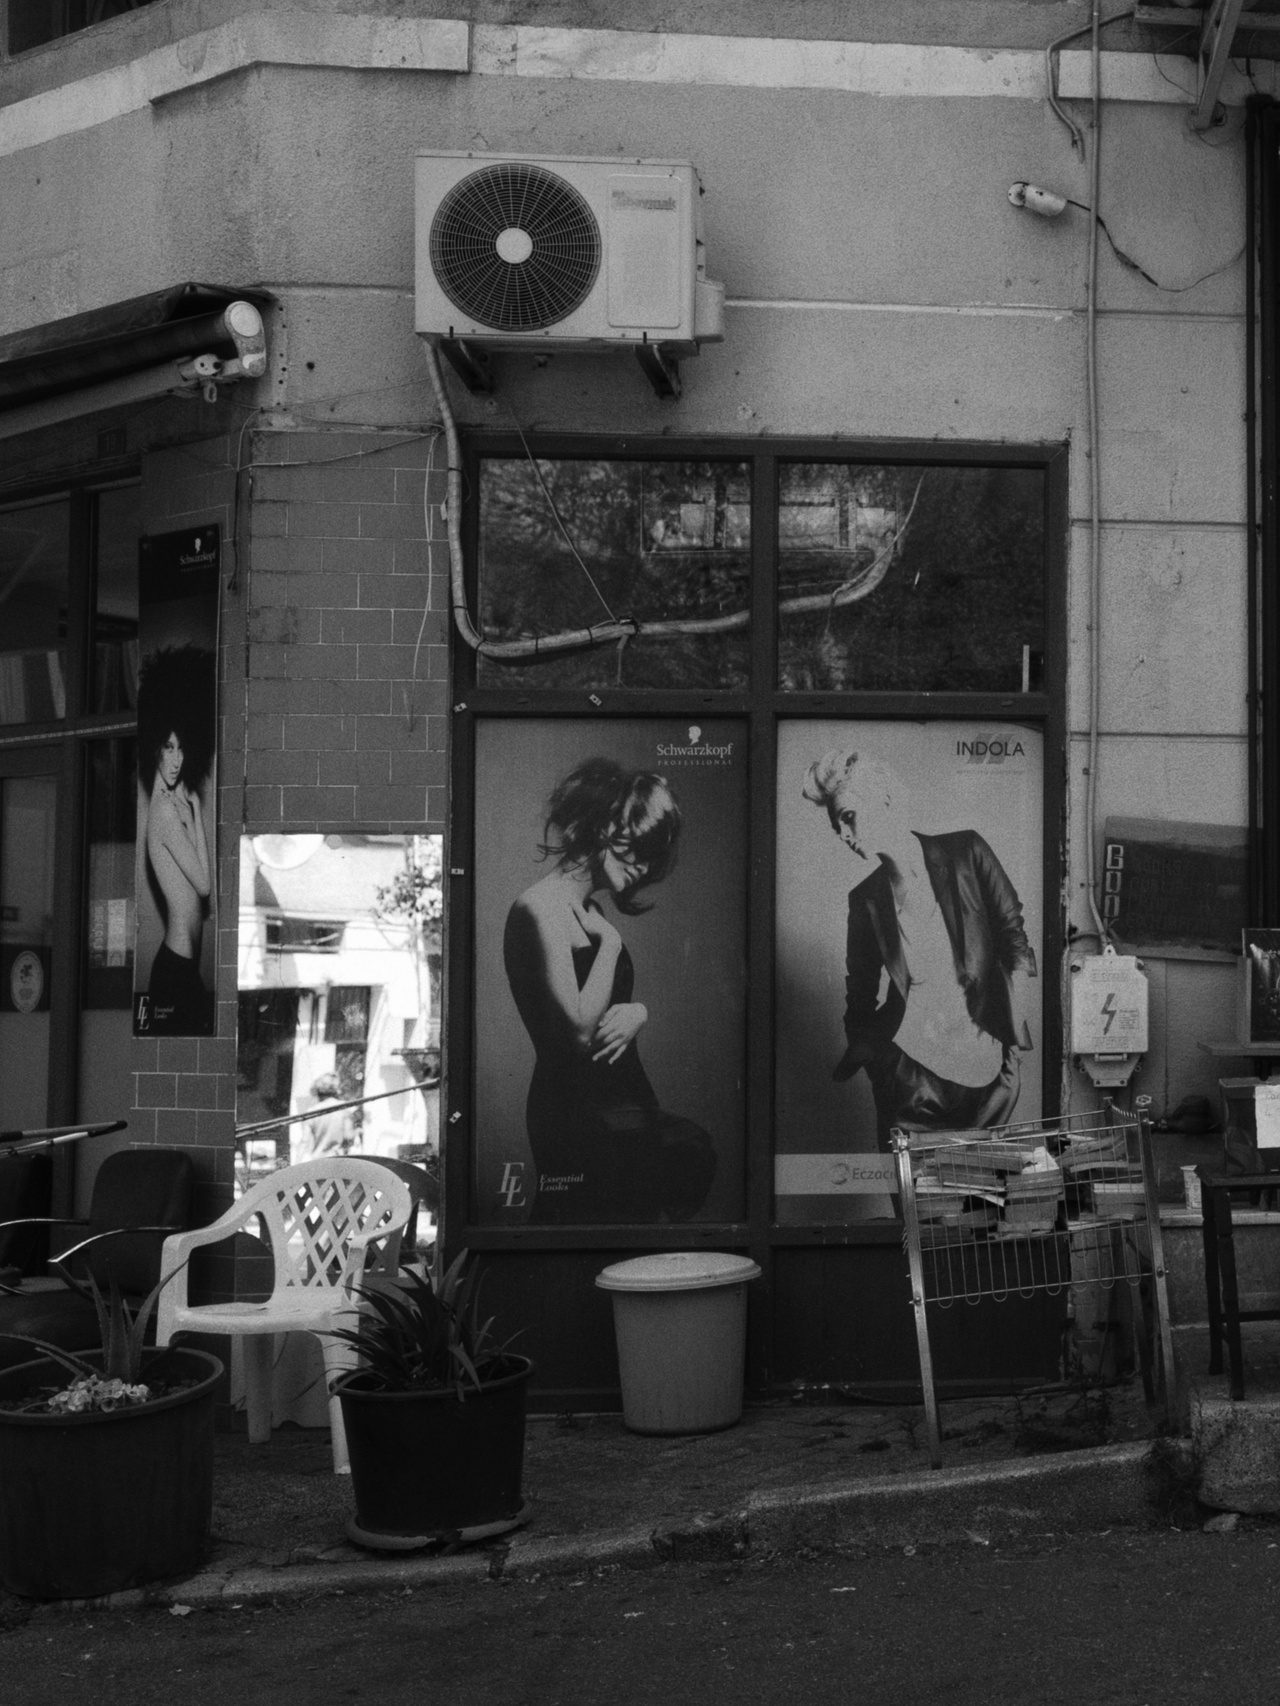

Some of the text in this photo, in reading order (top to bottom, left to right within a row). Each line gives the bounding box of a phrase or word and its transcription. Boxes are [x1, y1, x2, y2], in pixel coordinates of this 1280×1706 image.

[656, 742, 734, 759] Schwarzkopf
[956, 741, 1026, 757] INDOLA
[540, 1173, 585, 1184] Essential
[540, 1182, 570, 1192] Looks
